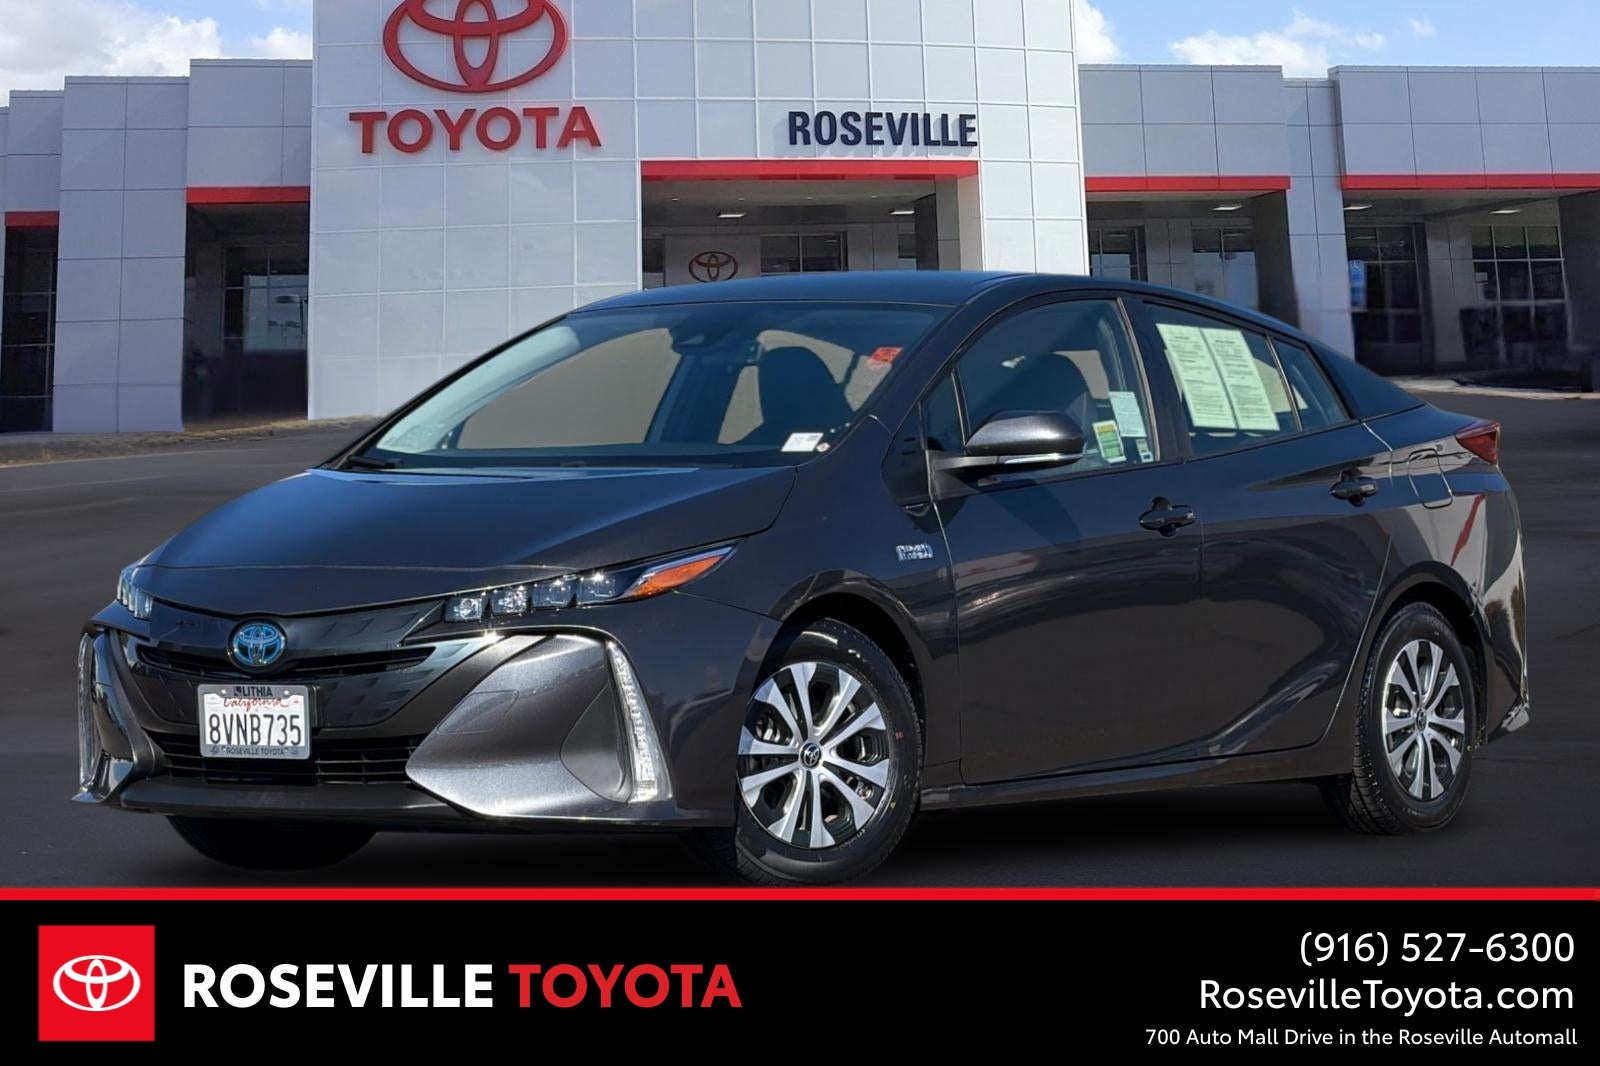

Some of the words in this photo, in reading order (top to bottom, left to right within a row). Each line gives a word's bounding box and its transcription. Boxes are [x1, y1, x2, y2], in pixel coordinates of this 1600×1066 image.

[349, 106, 602, 154] TOYOTA
[788, 110, 978, 147] ROSEVILLE
[242, 686, 273, 697] LITHIA
[223, 697, 289, 712] California
[209, 713, 301, 746] 8VNB735
[226, 746, 259, 755] ROSEVILLE
[260, 747, 285, 756] TOYOTA
